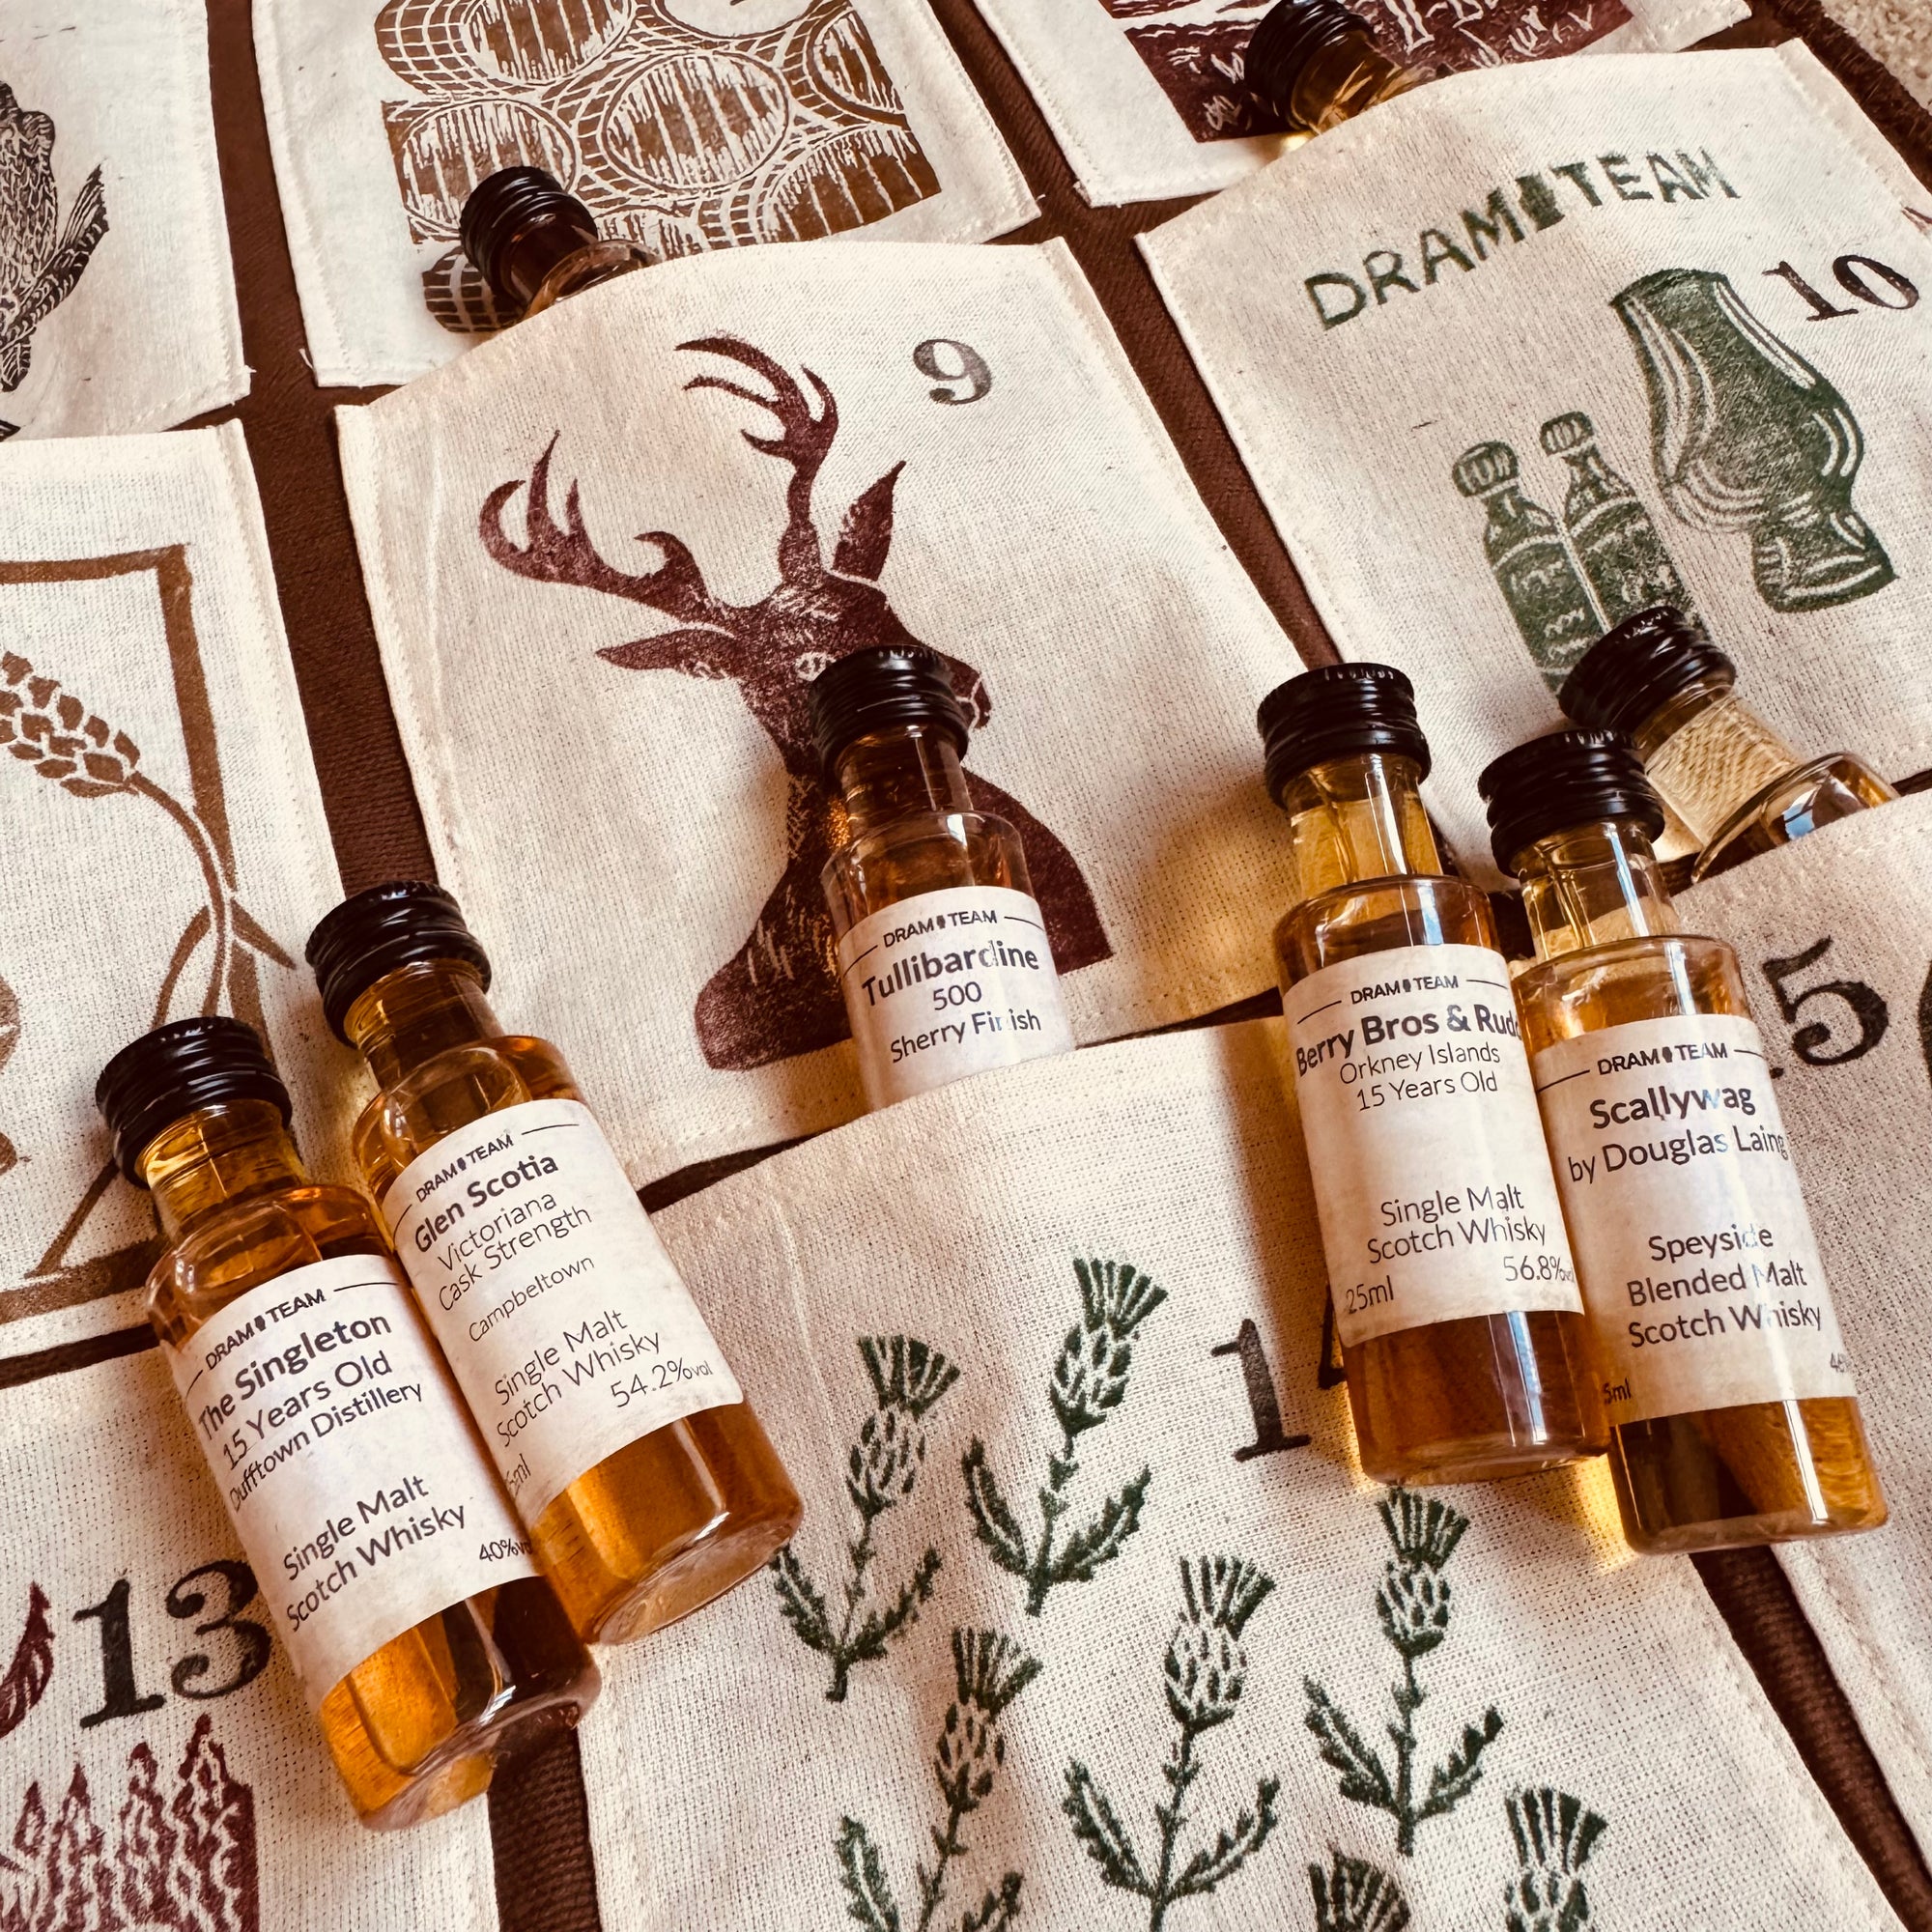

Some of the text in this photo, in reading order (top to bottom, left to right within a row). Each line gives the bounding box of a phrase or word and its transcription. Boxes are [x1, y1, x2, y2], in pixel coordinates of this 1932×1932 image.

[1304, 146, 1741, 331] DRAM TEAM
[1762, 254, 1919, 322] 10
[913, 339, 992, 406] 9
[883, 910, 997, 949] DRAM TEAM
[862, 940, 1040, 1007] Tullibardine
[933, 980, 982, 1011] 500
[1350, 975, 1459, 1005] DRAM TEAM
[1761, 934, 1889, 1079] 5
[890, 1021, 966, 1064] Sherry
[1295, 1029, 1354, 1078] Berry
[1361, 1013, 1439, 1046] Bros
[1447, 1004, 1471, 1033] &
[1340, 1041, 1500, 1084] Orkney Islands
[1597, 1042, 1728, 1075] DRAM TEAM
[1356, 1069, 1498, 1111] 15 Years Old
[1590, 1085, 1756, 1129] Scallywag
[415, 1133, 515, 1203] DRAM TEAM
[1568, 1124, 1790, 1184] by Douglas Laing
[414, 1154, 559, 1253] Glen Scotia
[438, 1193, 557, 1272] Victoriana
[1380, 1183, 1524, 1227] Single Malt
[439, 1206, 592, 1311] Cask Strength
[1367, 1215, 1546, 1264] Scotch Whisky
[1648, 1223, 1774, 1264] Speyside
[469, 1257, 595, 1342] Campbeltown
[1345, 1275, 1394, 1315] 25ml
[1627, 1260, 1808, 1307] Blended Malt
[205, 1288, 327, 1371] DRAM TEAM
[495, 1310, 629, 1406] Single Malt
[1629, 1309, 1726, 1348] Scotch
[198, 1315, 392, 1440] The Singleton
[222, 1350, 392, 1471] 15 Years Old
[497, 1331, 661, 1448] Scotch Whisky
[229, 1383, 423, 1513] Dufftown Distillery
[283, 1475, 429, 1581] Single Malt
[286, 1505, 466, 1633] Scotch Whisky
[72, 1558, 272, 1729] 13
